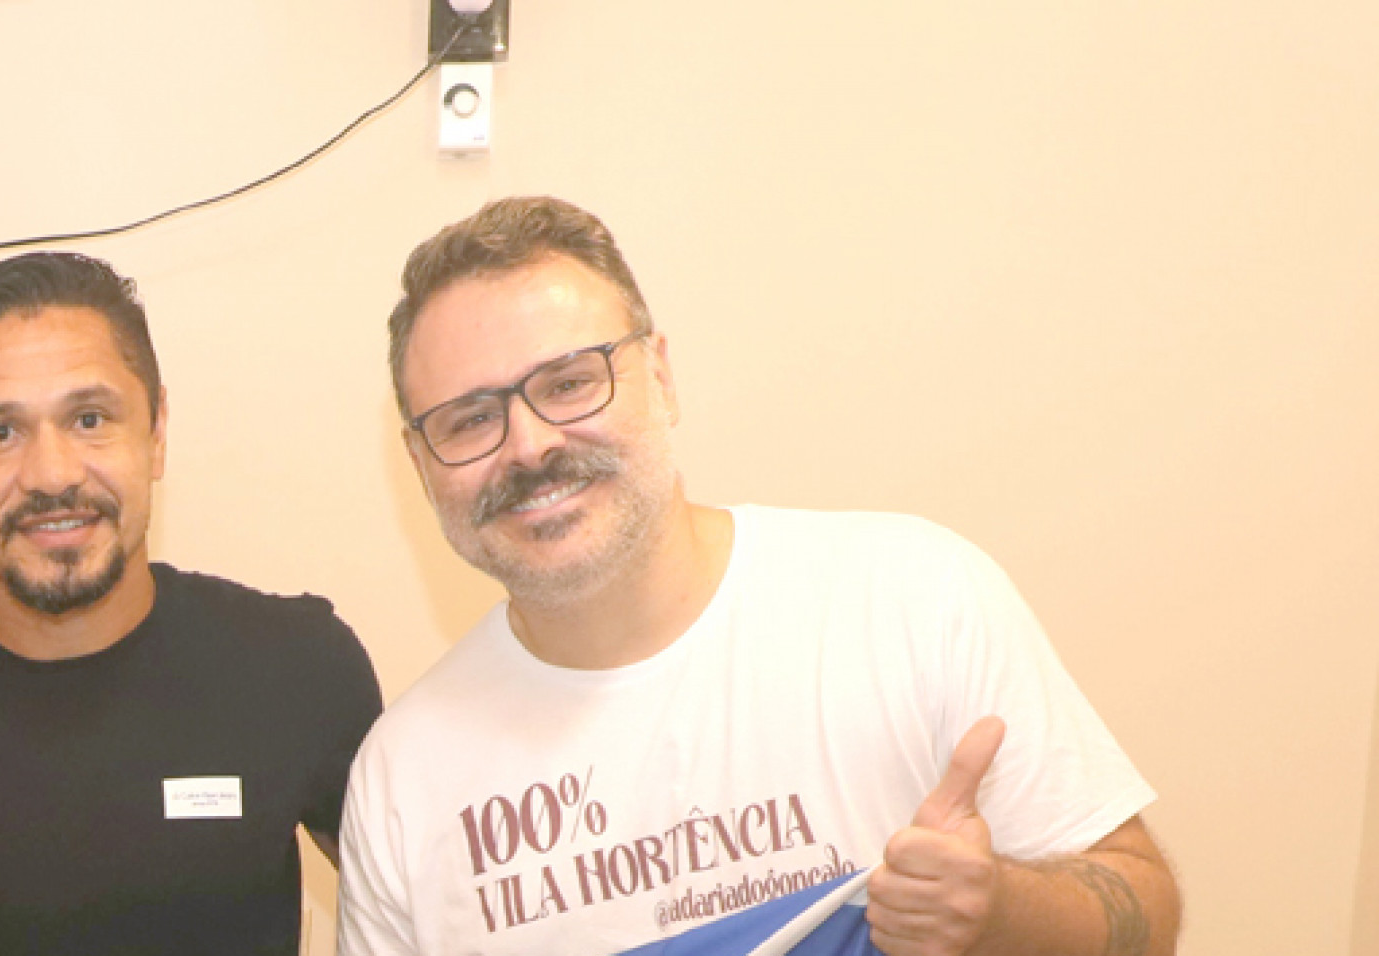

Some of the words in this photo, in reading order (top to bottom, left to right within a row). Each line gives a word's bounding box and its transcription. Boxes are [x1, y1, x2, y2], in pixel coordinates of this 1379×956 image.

[460, 764, 608, 876] 100%
[476, 865, 569, 933] VILA
[573, 793, 816, 906] HORTÊNCIA
